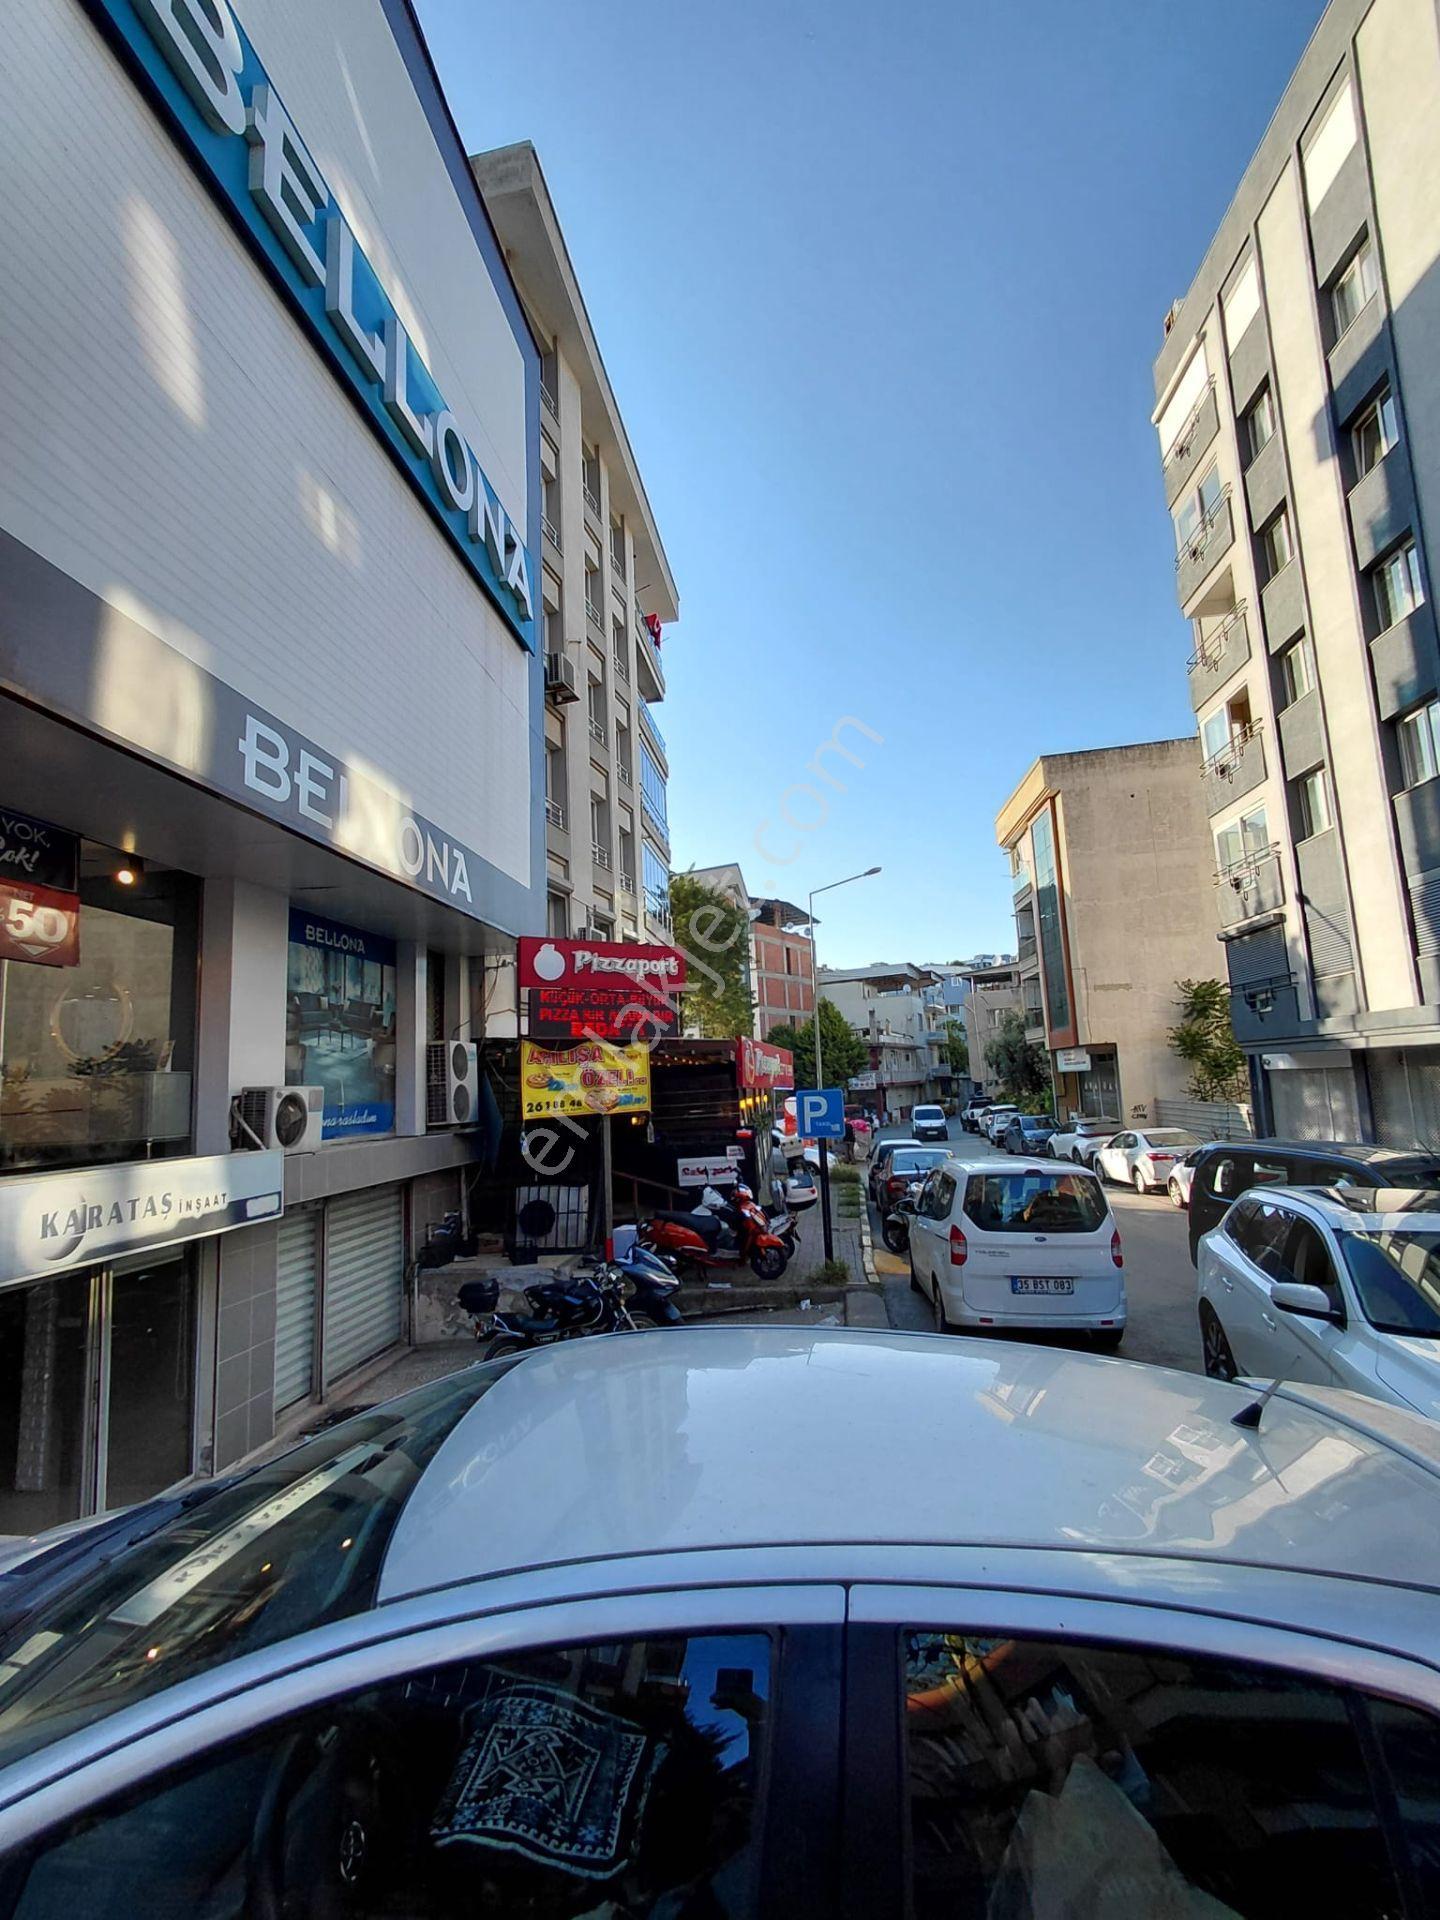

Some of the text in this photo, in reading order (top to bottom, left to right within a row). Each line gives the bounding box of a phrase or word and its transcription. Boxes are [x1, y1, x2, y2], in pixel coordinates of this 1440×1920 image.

[238, 714, 472, 903] BELONA
[305, 924, 366, 955] BELLONA
[572, 950, 679, 982] Pizzaport
[804, 1096, 828, 1133] P
[40, 1192, 228, 1240] KARATAŞ İNŞAAT
[1018, 1279, 1030, 1290] 35
[1033, 1279, 1050, 1290] BST
